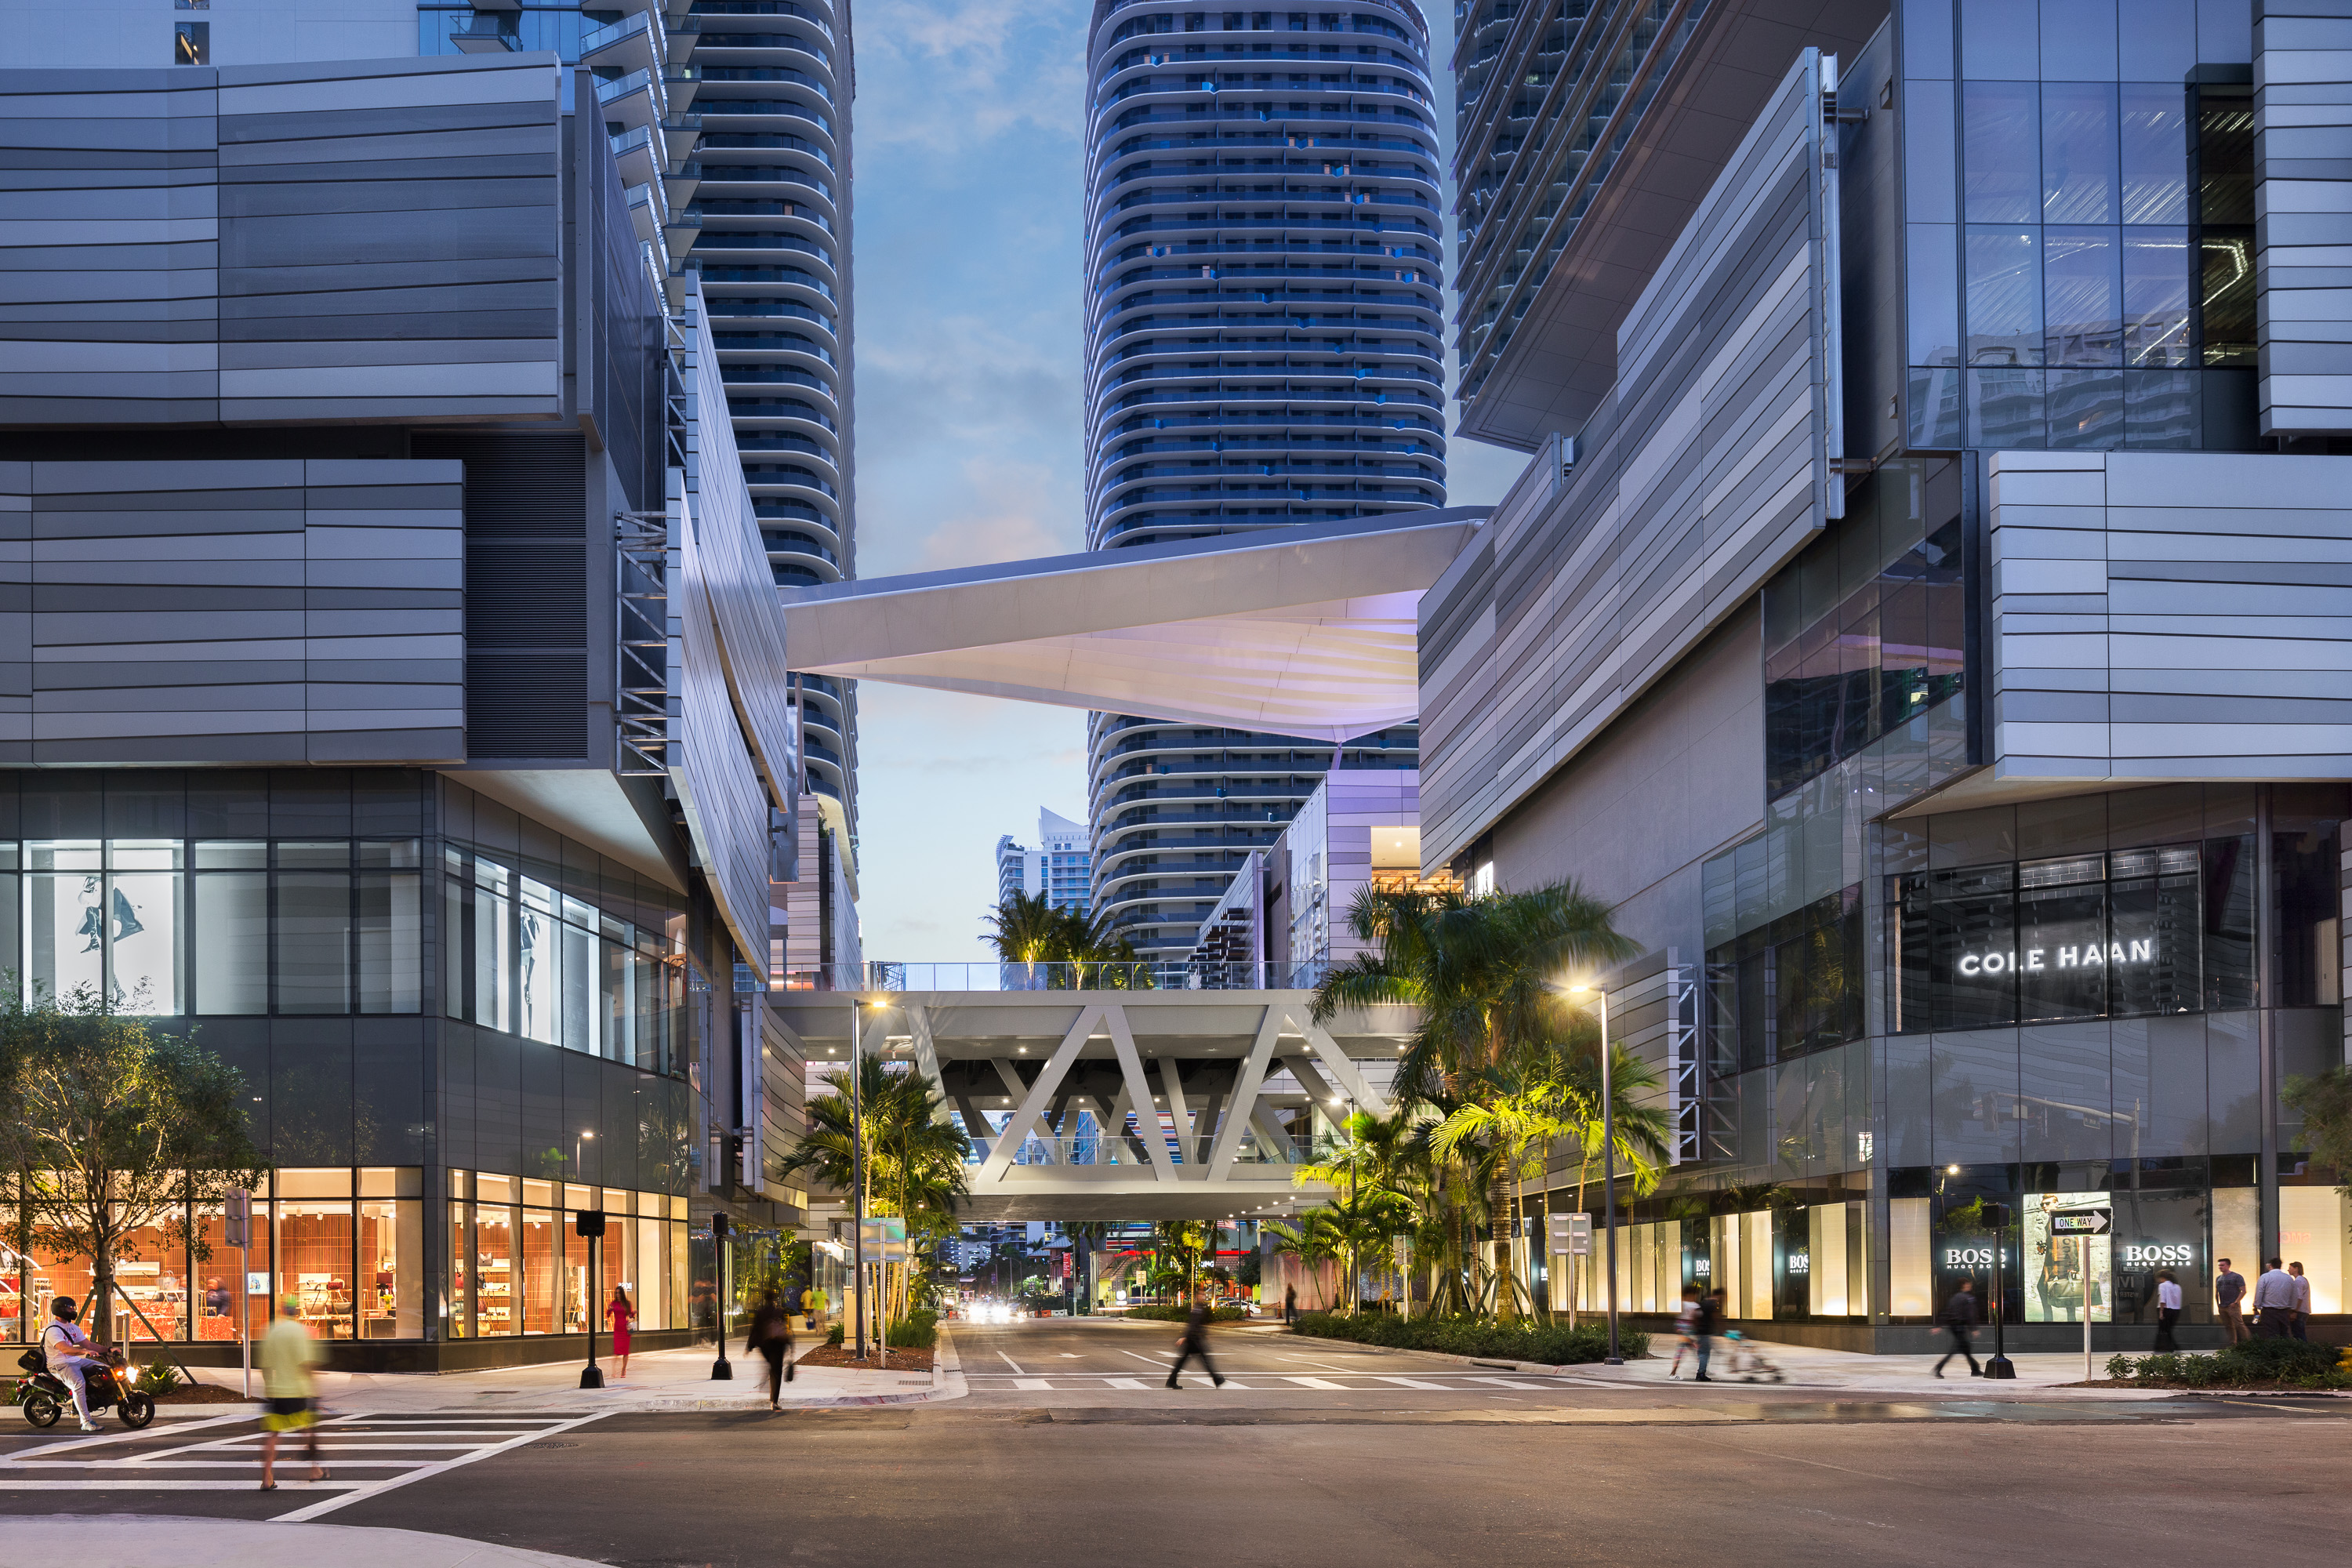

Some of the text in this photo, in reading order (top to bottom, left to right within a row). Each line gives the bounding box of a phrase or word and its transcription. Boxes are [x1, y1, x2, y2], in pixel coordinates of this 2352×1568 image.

[1961, 940, 2151, 975] COLE HAAN
[2059, 1217, 2092, 1227] ONE WAY
[2125, 1245, 2192, 1261] BOSS
